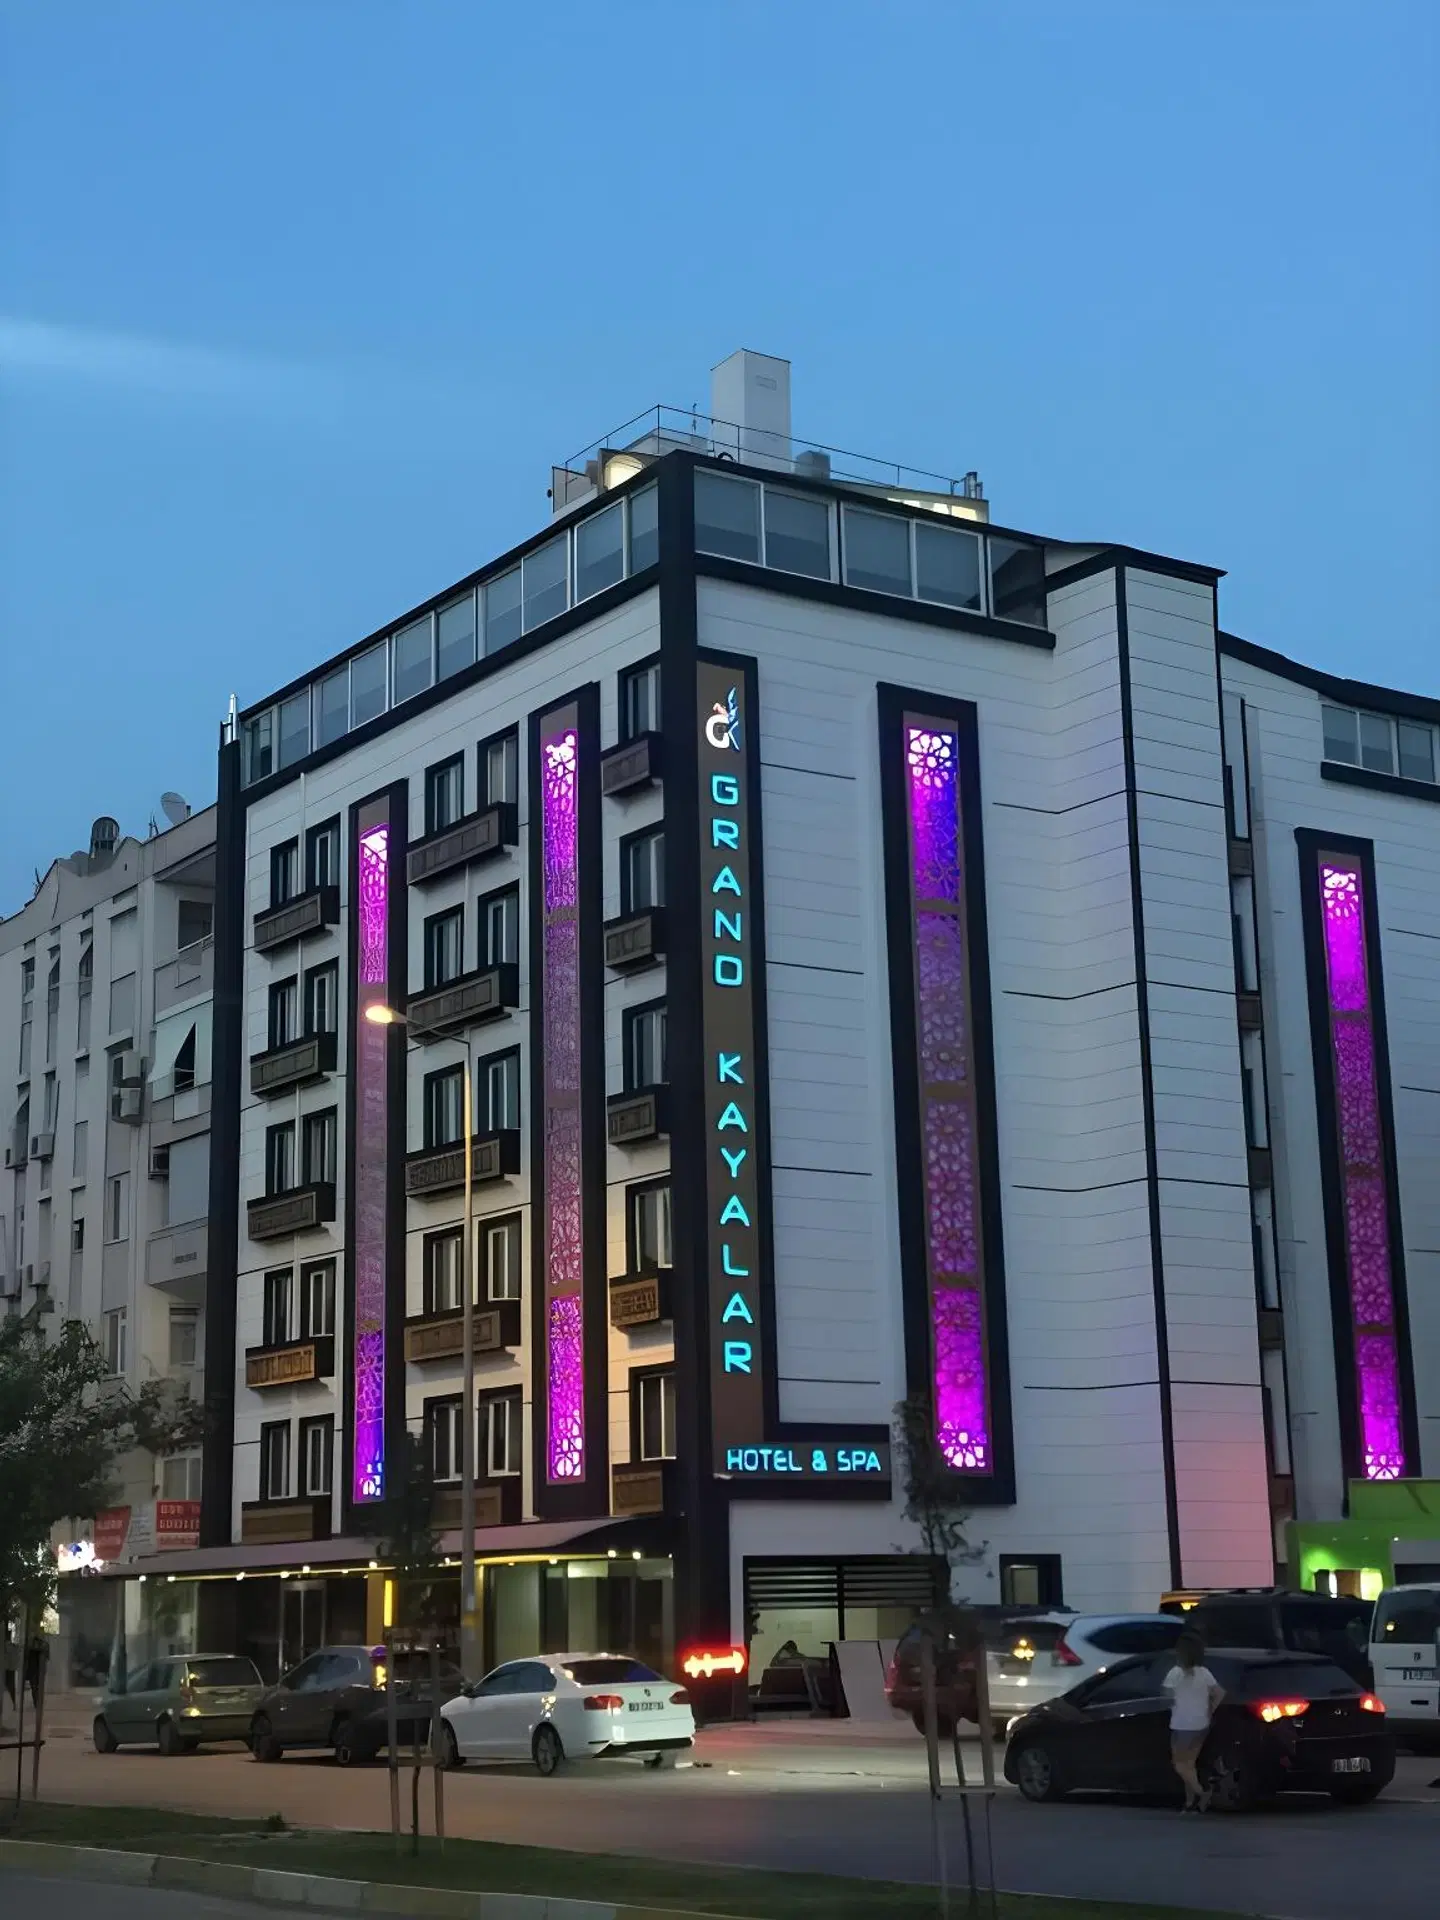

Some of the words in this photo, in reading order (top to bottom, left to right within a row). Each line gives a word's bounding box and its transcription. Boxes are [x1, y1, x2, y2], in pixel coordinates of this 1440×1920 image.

[712, 774, 744, 987] GRAND
[717, 1051, 754, 1374] KAYALAR
[727, 1448, 803, 1472] HOTEL
[811, 1449, 828, 1472] &
[837, 1449, 882, 1472] SPA
